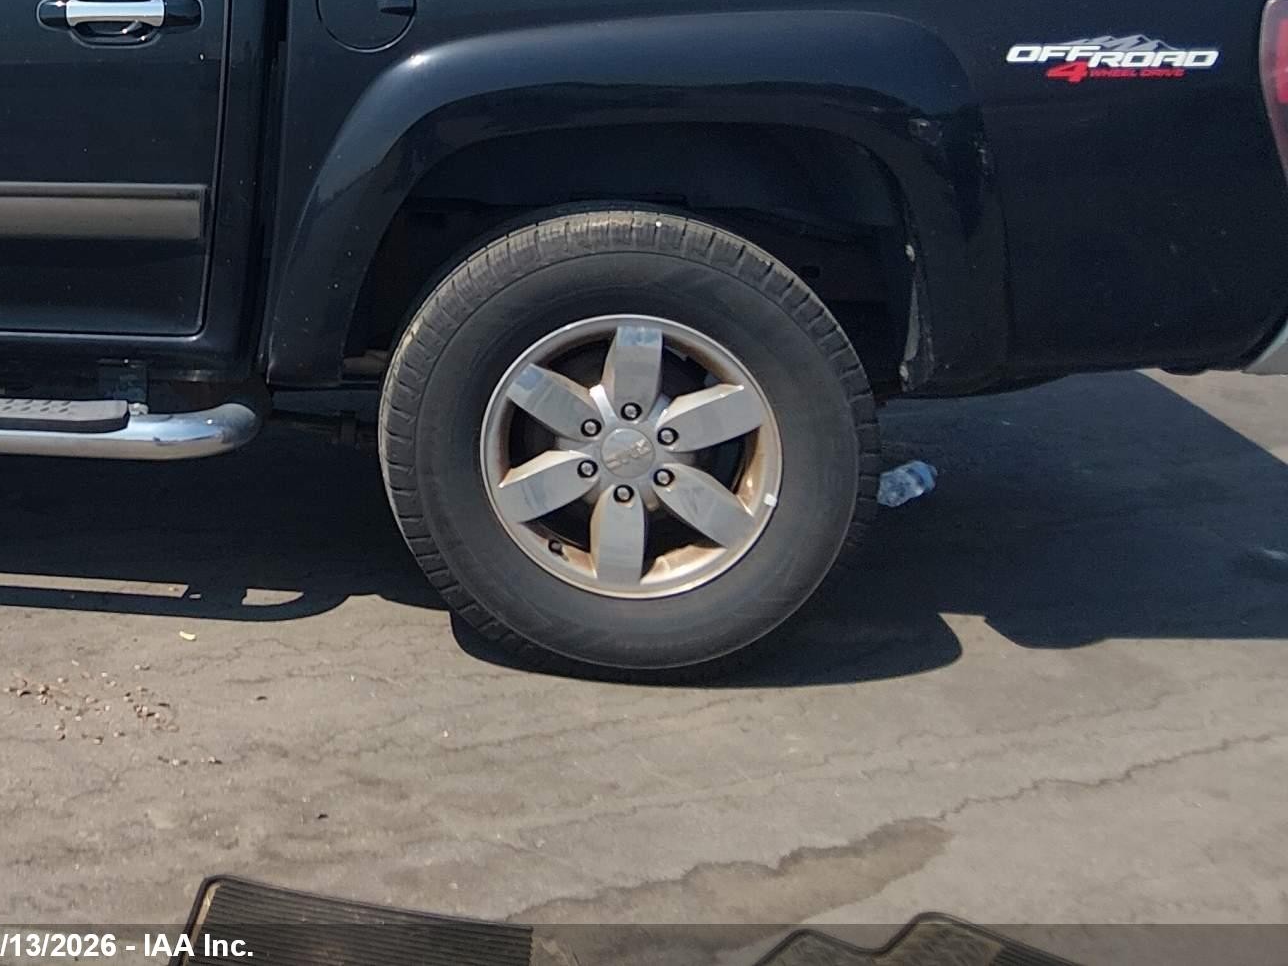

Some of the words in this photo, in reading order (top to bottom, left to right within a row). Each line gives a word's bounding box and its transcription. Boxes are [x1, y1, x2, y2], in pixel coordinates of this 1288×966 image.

[1047, 61, 1089, 83] 4
[1089, 68, 1138, 78] WHEEL
[1139, 68, 1185, 78] DRIVE
